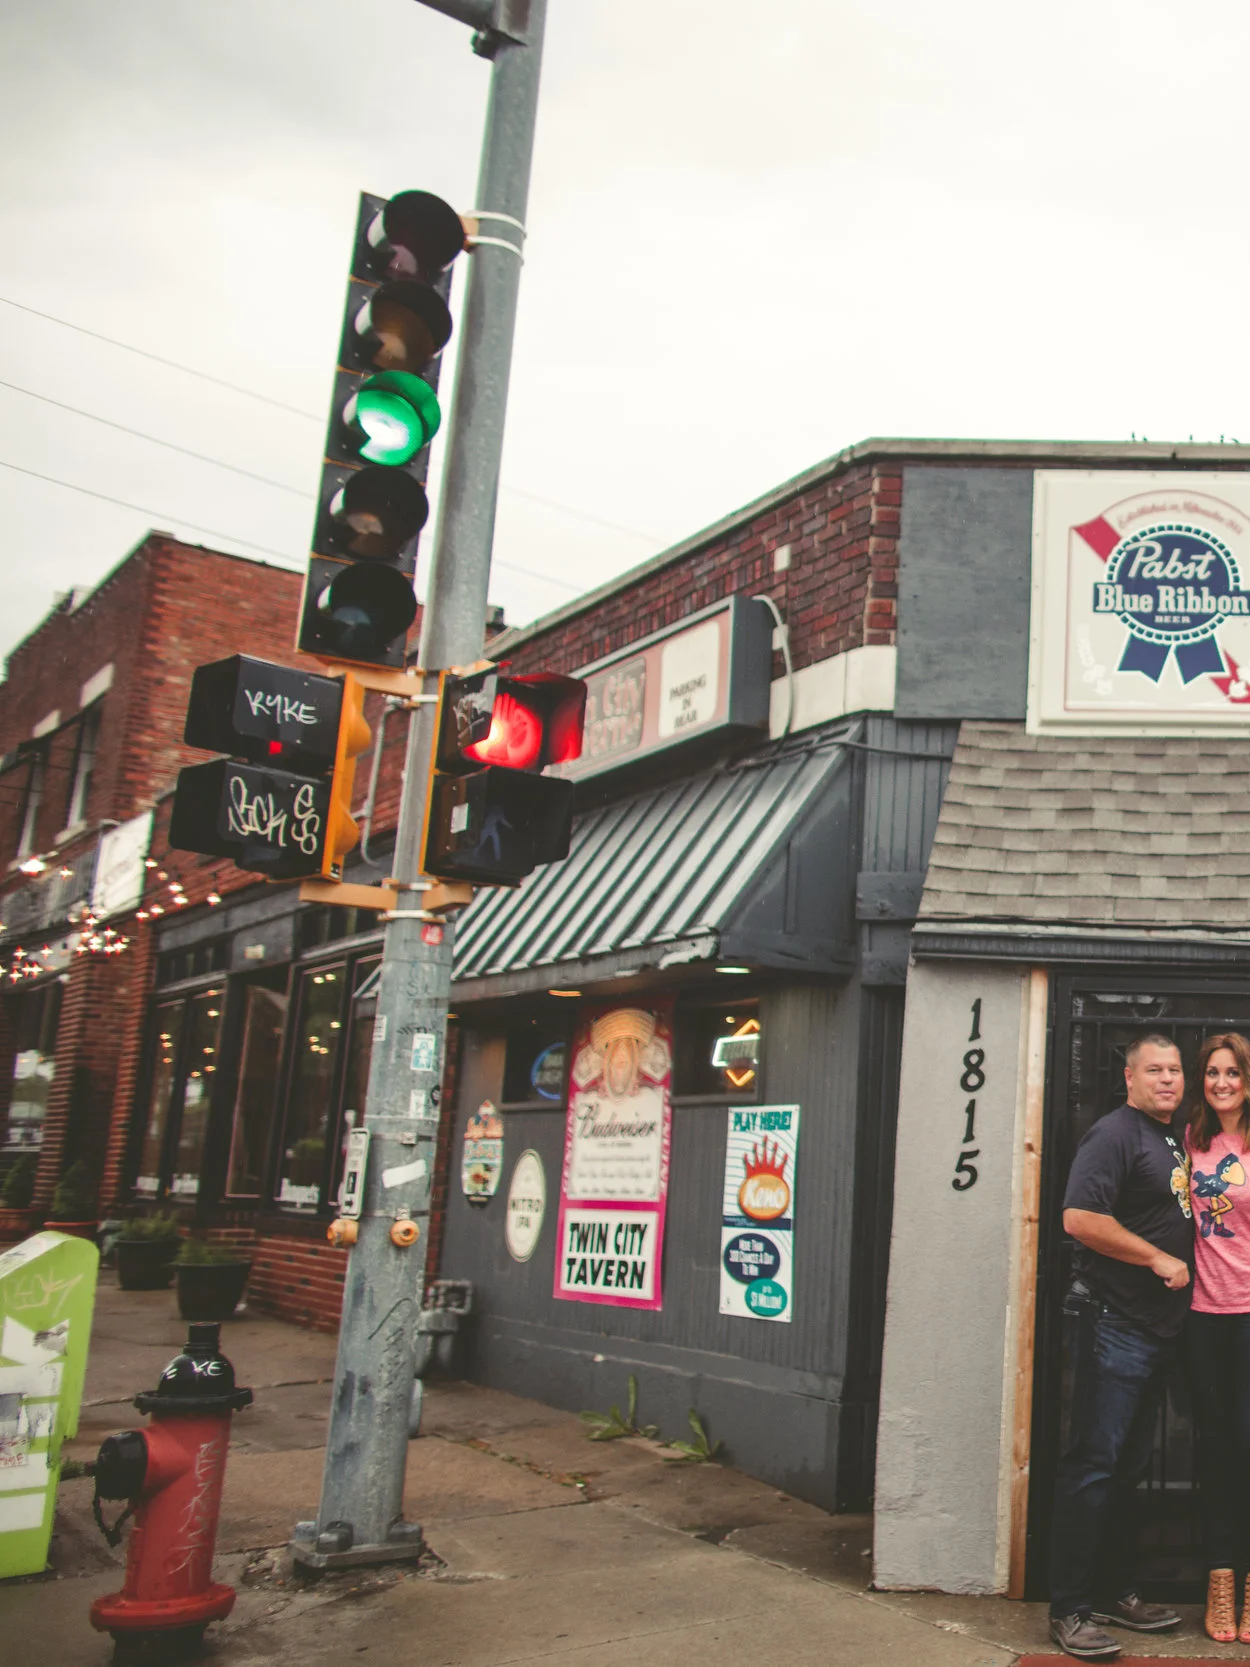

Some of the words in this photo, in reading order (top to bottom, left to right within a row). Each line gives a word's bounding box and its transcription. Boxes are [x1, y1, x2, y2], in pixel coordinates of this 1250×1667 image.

[1125, 540, 1217, 580] Pabst
[1095, 583, 1153, 613] Blue
[1156, 585, 1249, 615] Ribbon
[1154, 615, 1191, 624] BEER
[669, 673, 707, 698] PARKING
[682, 700, 692, 711] IN
[951, 998, 985, 1191] 1815
[576, 1102, 658, 1139] Budweiser
[733, 1111, 758, 1132] PLAY
[510, 1198, 542, 1213] NITRO
[742, 1180, 785, 1210] Keno
[569, 1223, 609, 1254] TWIN
[614, 1223, 648, 1256] CITY
[566, 1258, 646, 1289] TAVERN
